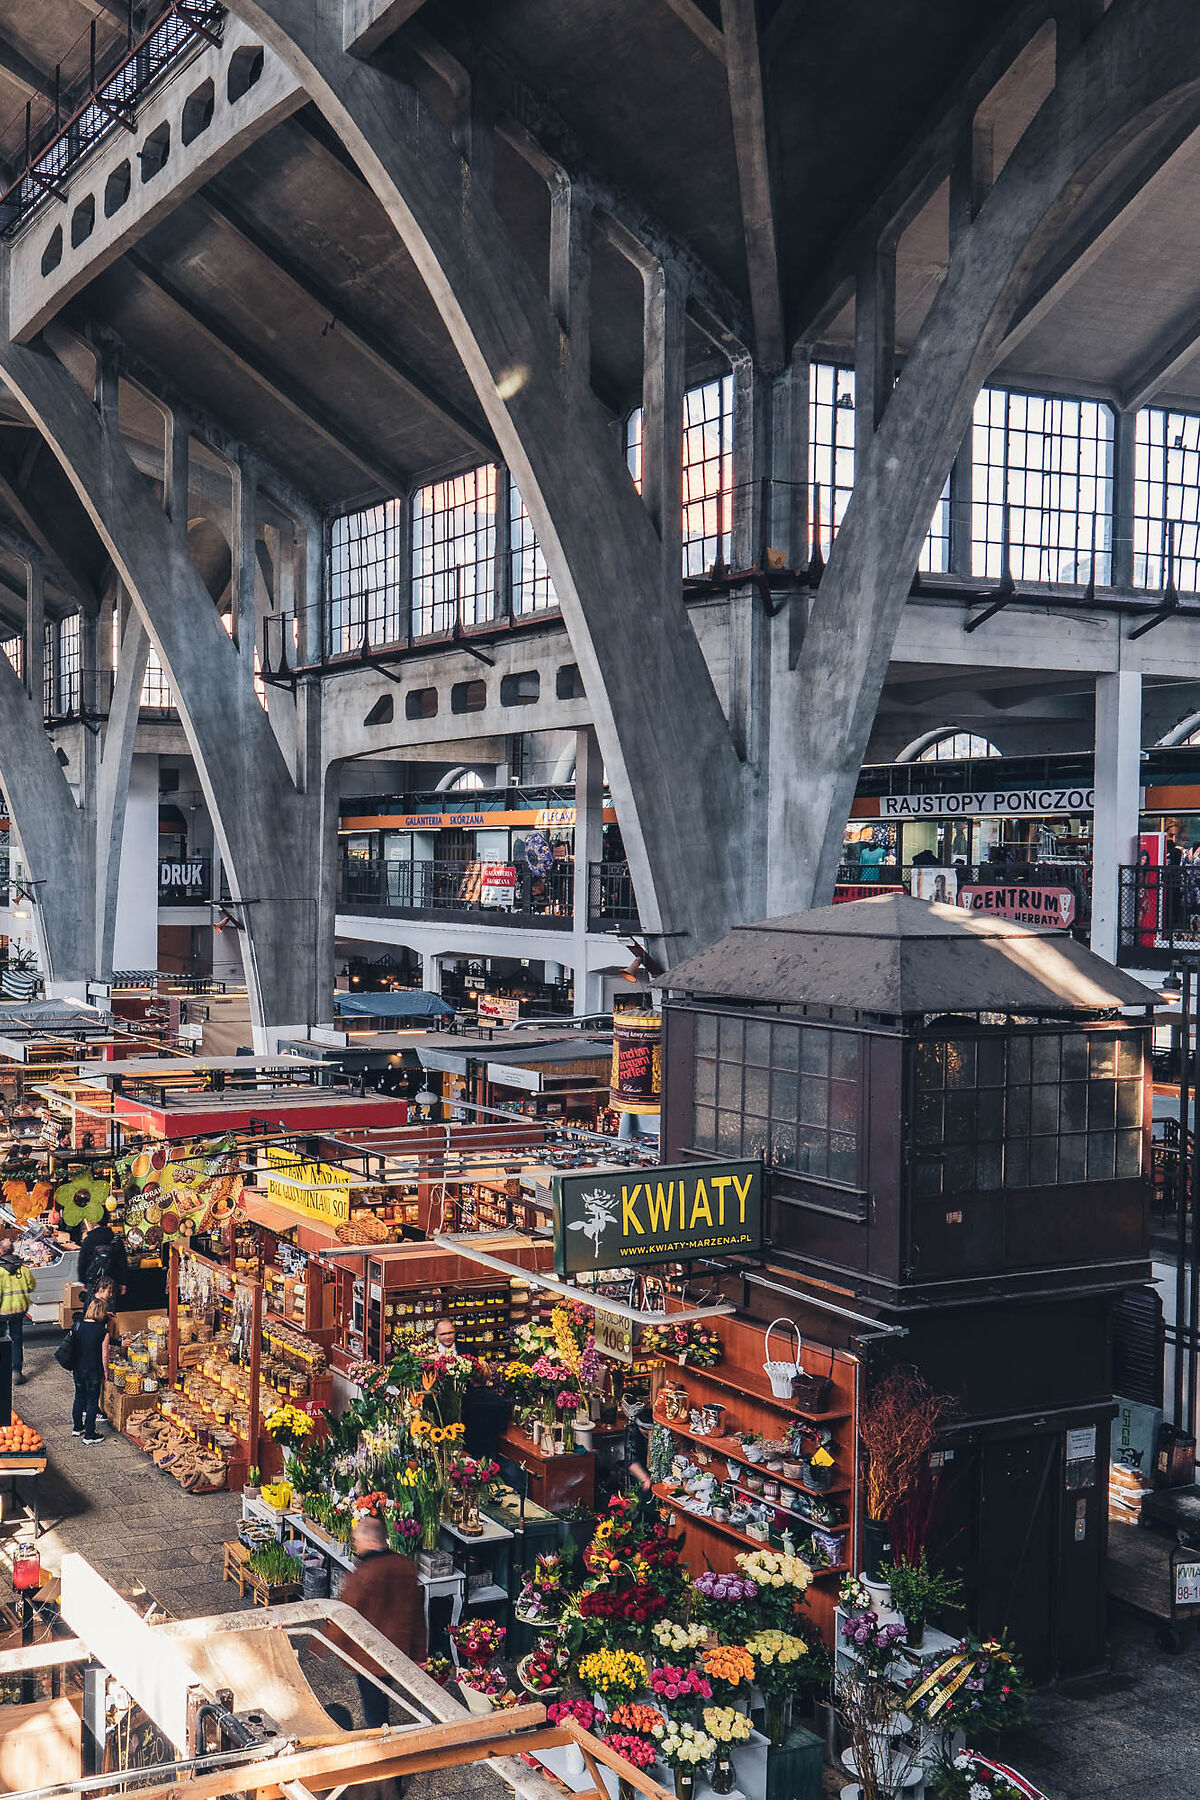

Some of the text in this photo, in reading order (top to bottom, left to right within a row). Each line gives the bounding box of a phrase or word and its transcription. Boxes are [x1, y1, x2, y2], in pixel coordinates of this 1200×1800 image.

[886, 794, 986, 813] RAJSTOPY
[405, 811, 573, 826] GALANTERIA SKÓRZANA PLECAKI
[161, 864, 203, 885] DRUK
[973, 889, 1059, 912] CENTRUM
[1015, 912, 1060, 925] HERBATY
[621, 1174, 753, 1236] KWIATY
[619, 1234, 752, 1257] WWW.KWIATY-MARZENA.PL
[603, 1326, 625, 1352] 106
